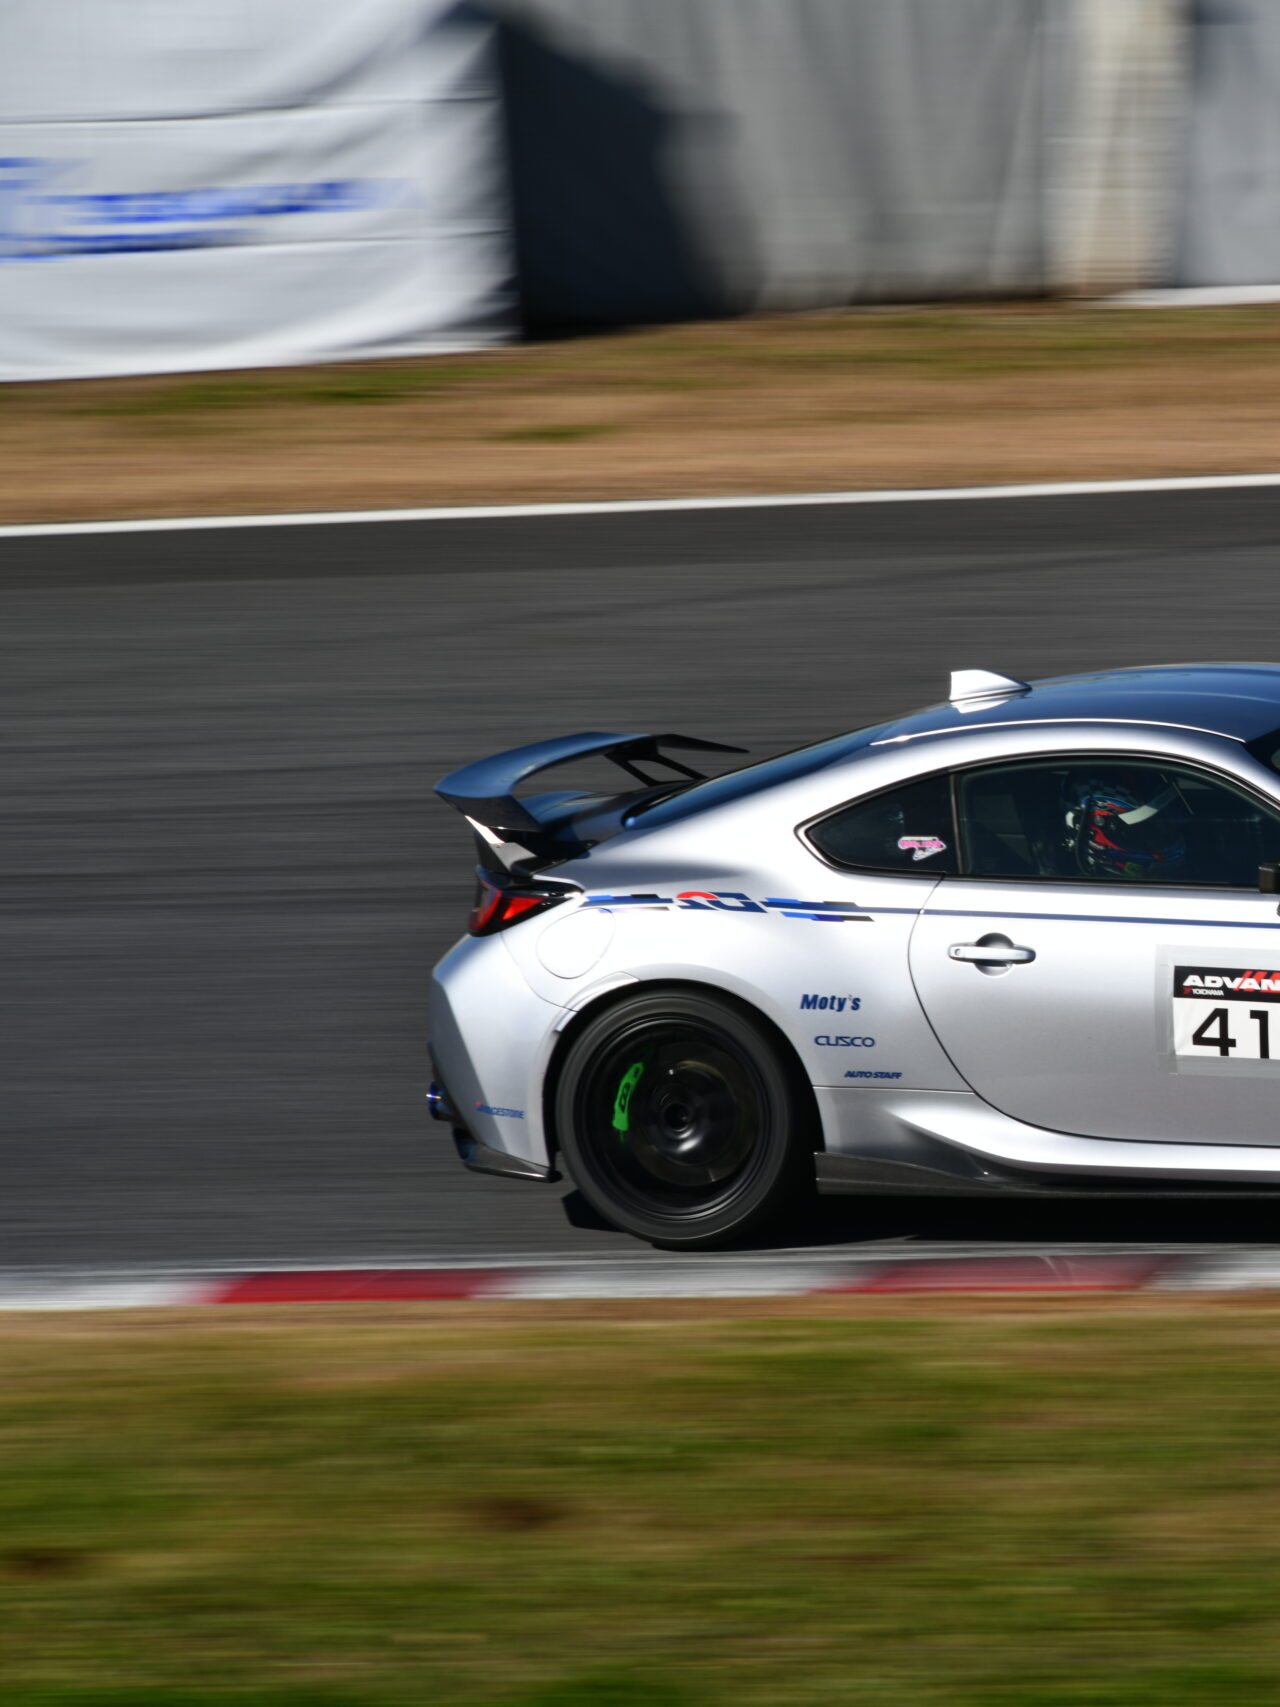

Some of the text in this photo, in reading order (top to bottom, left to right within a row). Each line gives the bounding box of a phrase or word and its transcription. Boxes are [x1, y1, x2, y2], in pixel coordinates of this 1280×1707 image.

[800, 994, 861, 1012] Moty's
[814, 1035, 876, 1047] CUSCO
[1192, 1007, 1270, 1060] 41
